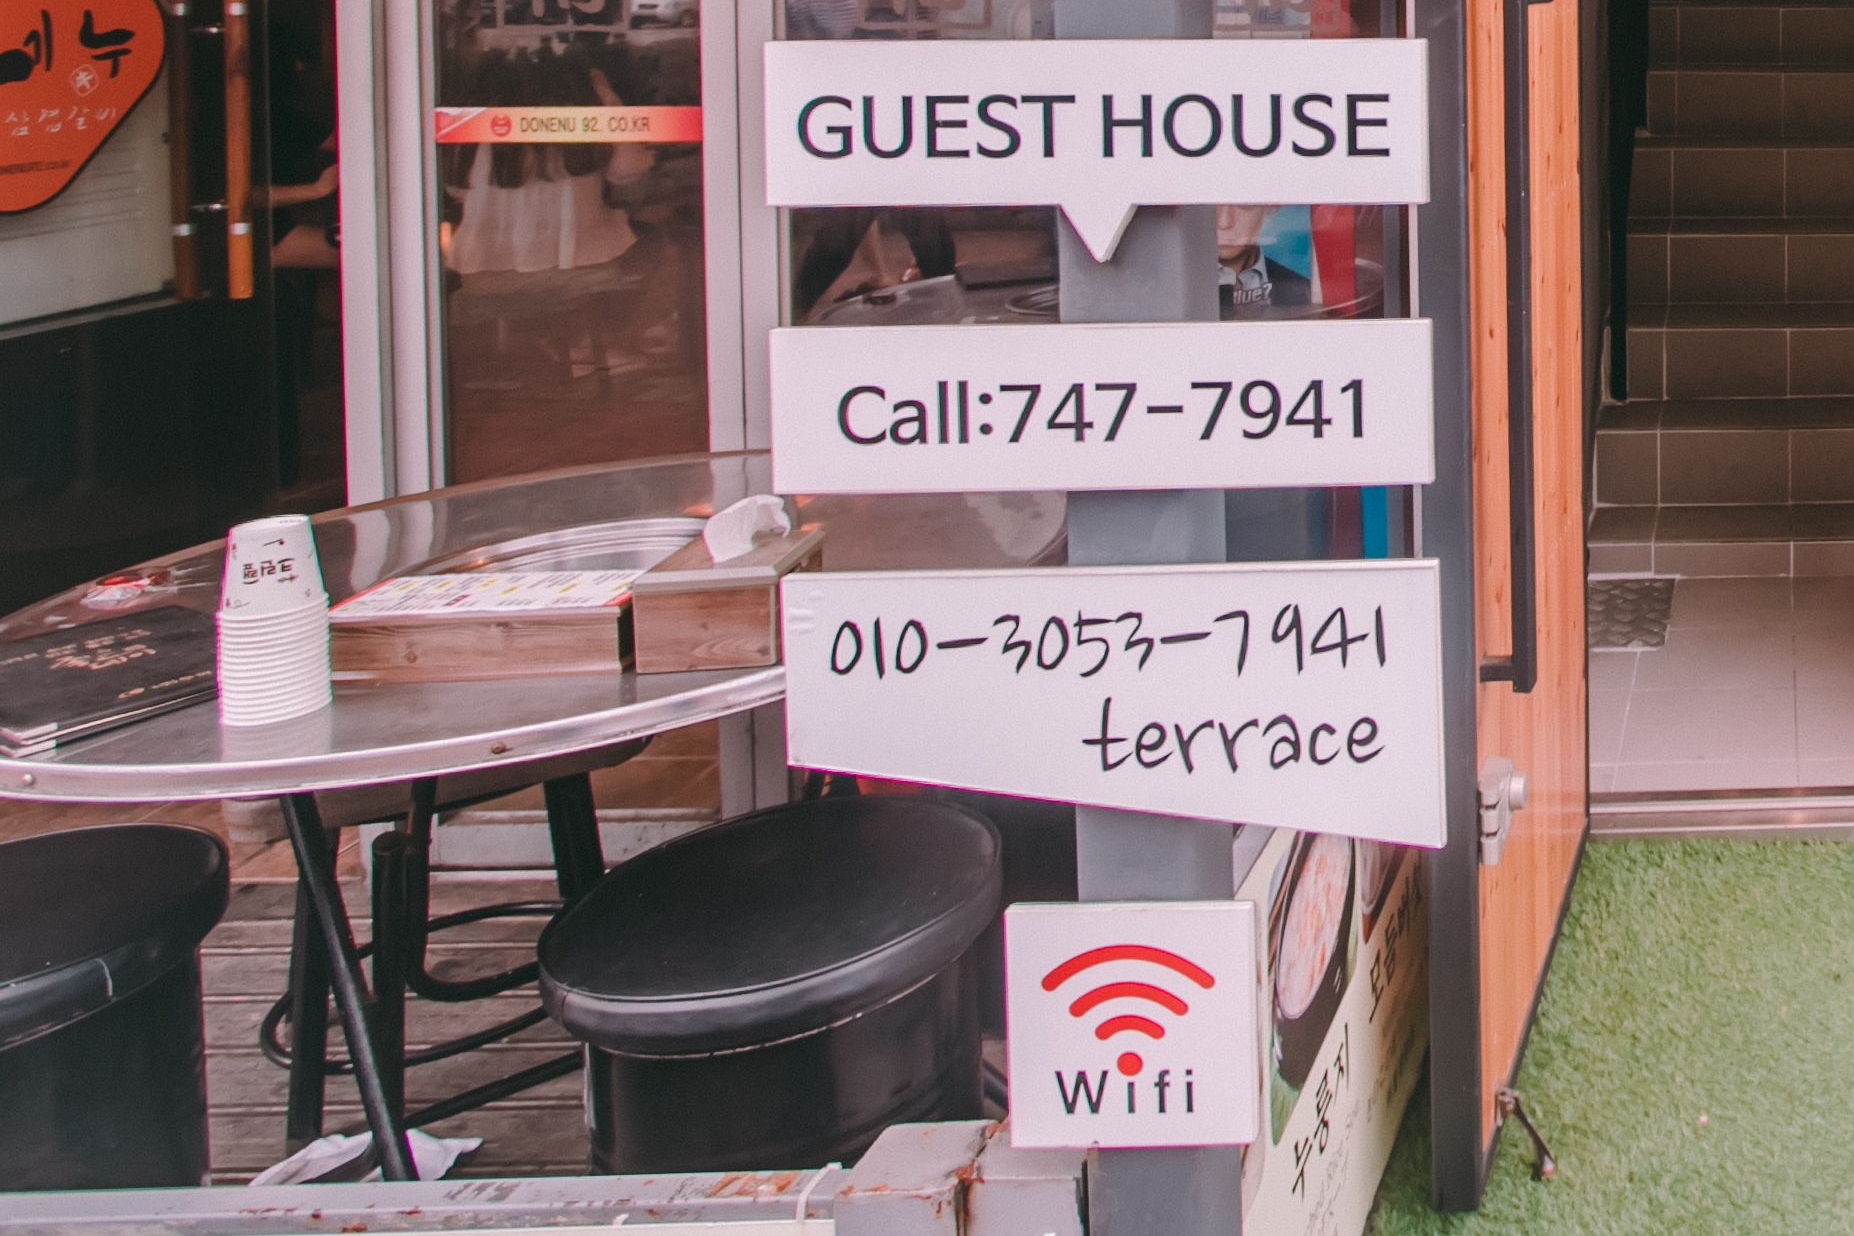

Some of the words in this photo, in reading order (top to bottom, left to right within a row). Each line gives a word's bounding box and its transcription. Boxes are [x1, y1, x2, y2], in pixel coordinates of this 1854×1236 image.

[520, 117, 576, 132] DONENU
[797, 94, 1076, 160] GUEST
[1101, 93, 1392, 159] HOUSE
[836, 378, 1366, 445] Call:747-7941
[830, 604, 1387, 679] 010-3053-7941
[1083, 696, 1385, 773] terrace
[1054, 1067, 1195, 1114] Wifi
